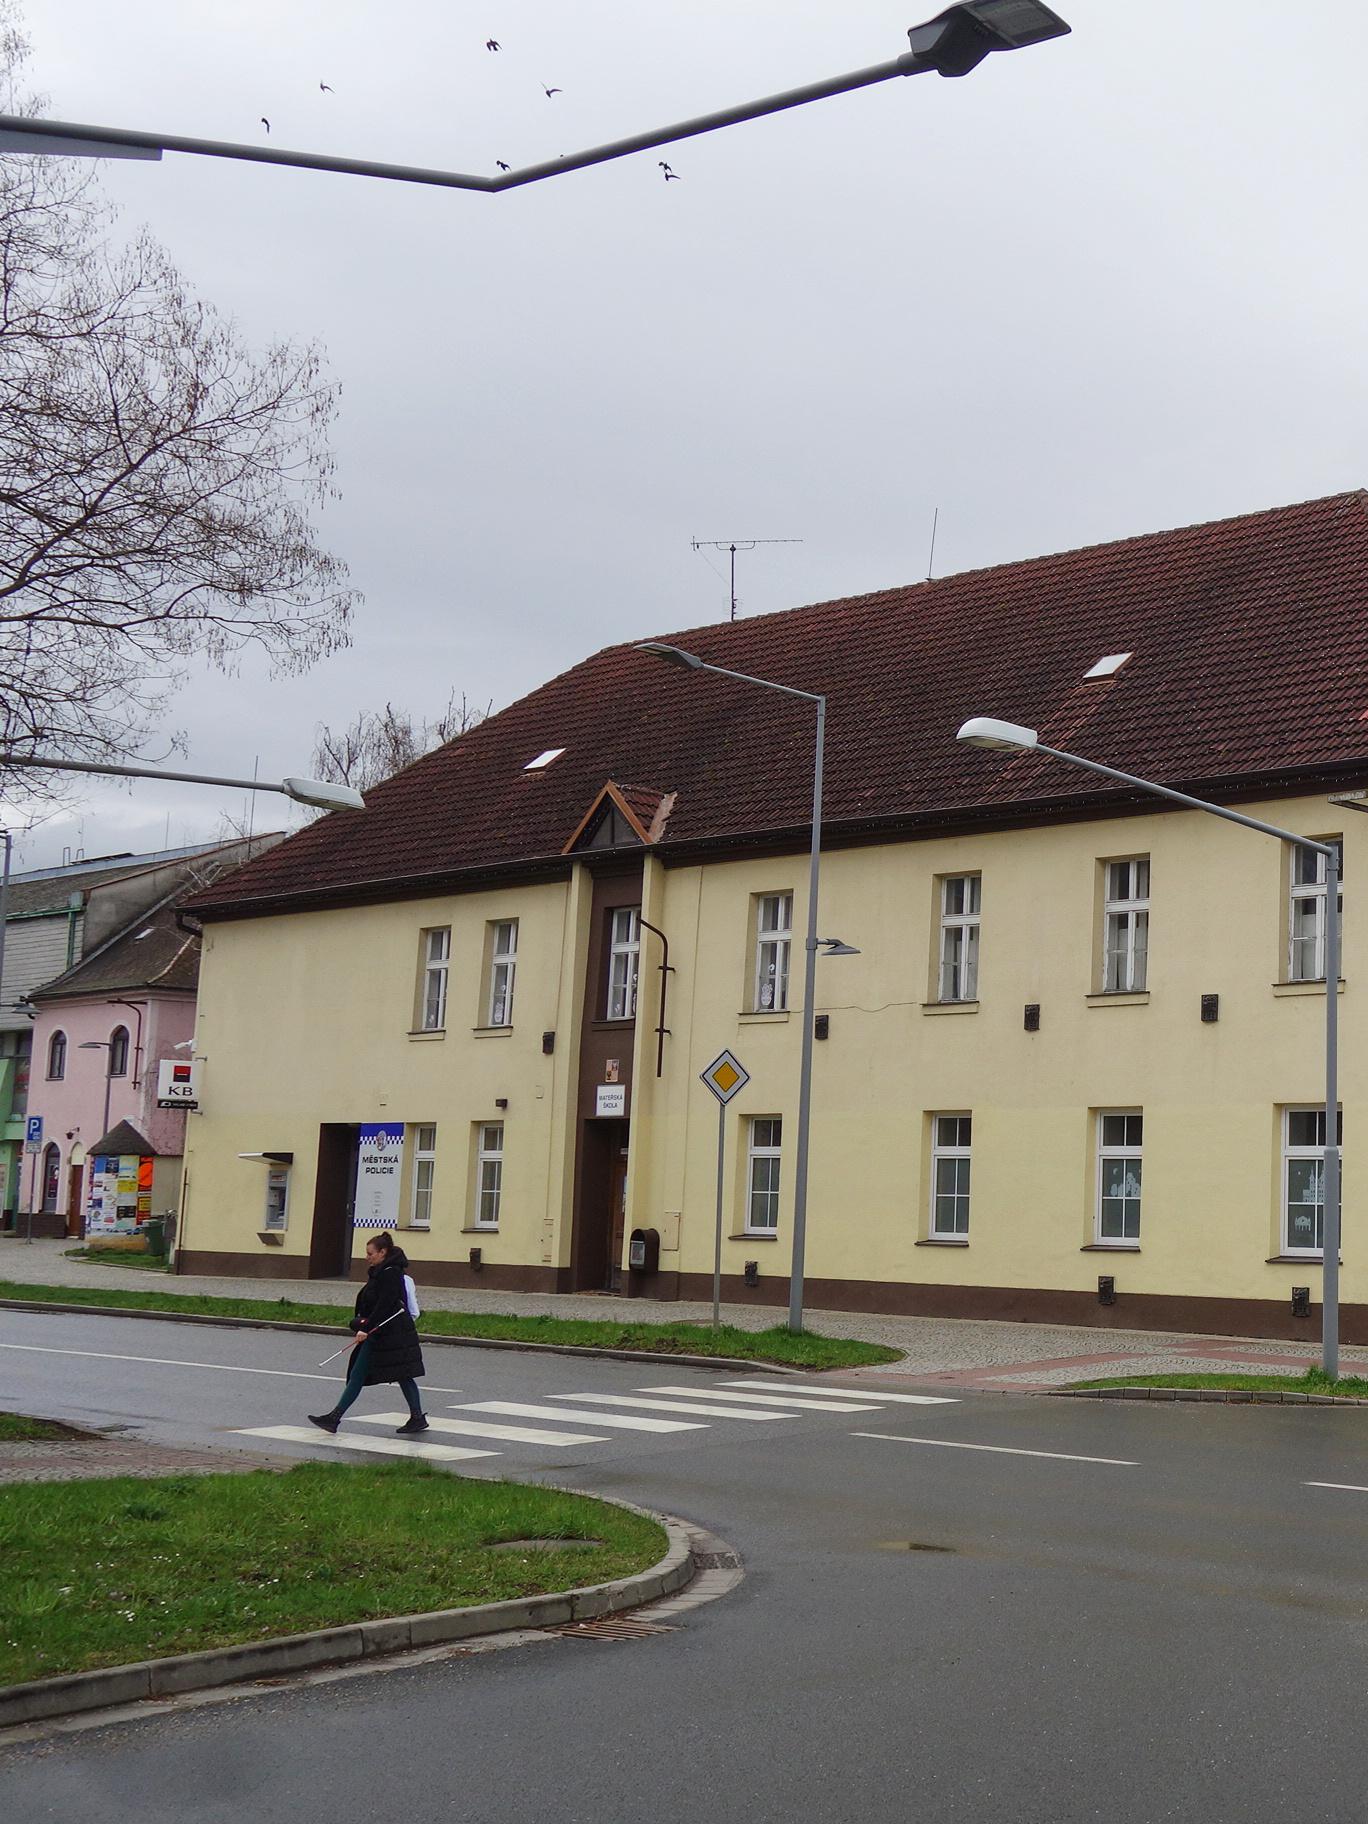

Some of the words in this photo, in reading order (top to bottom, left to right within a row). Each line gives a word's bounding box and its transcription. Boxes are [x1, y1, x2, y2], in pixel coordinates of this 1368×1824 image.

[168, 1086, 193, 1096] KB
[30, 1119, 39, 1133] P
[362, 1155, 399, 1163] MĚSTSKÁ
